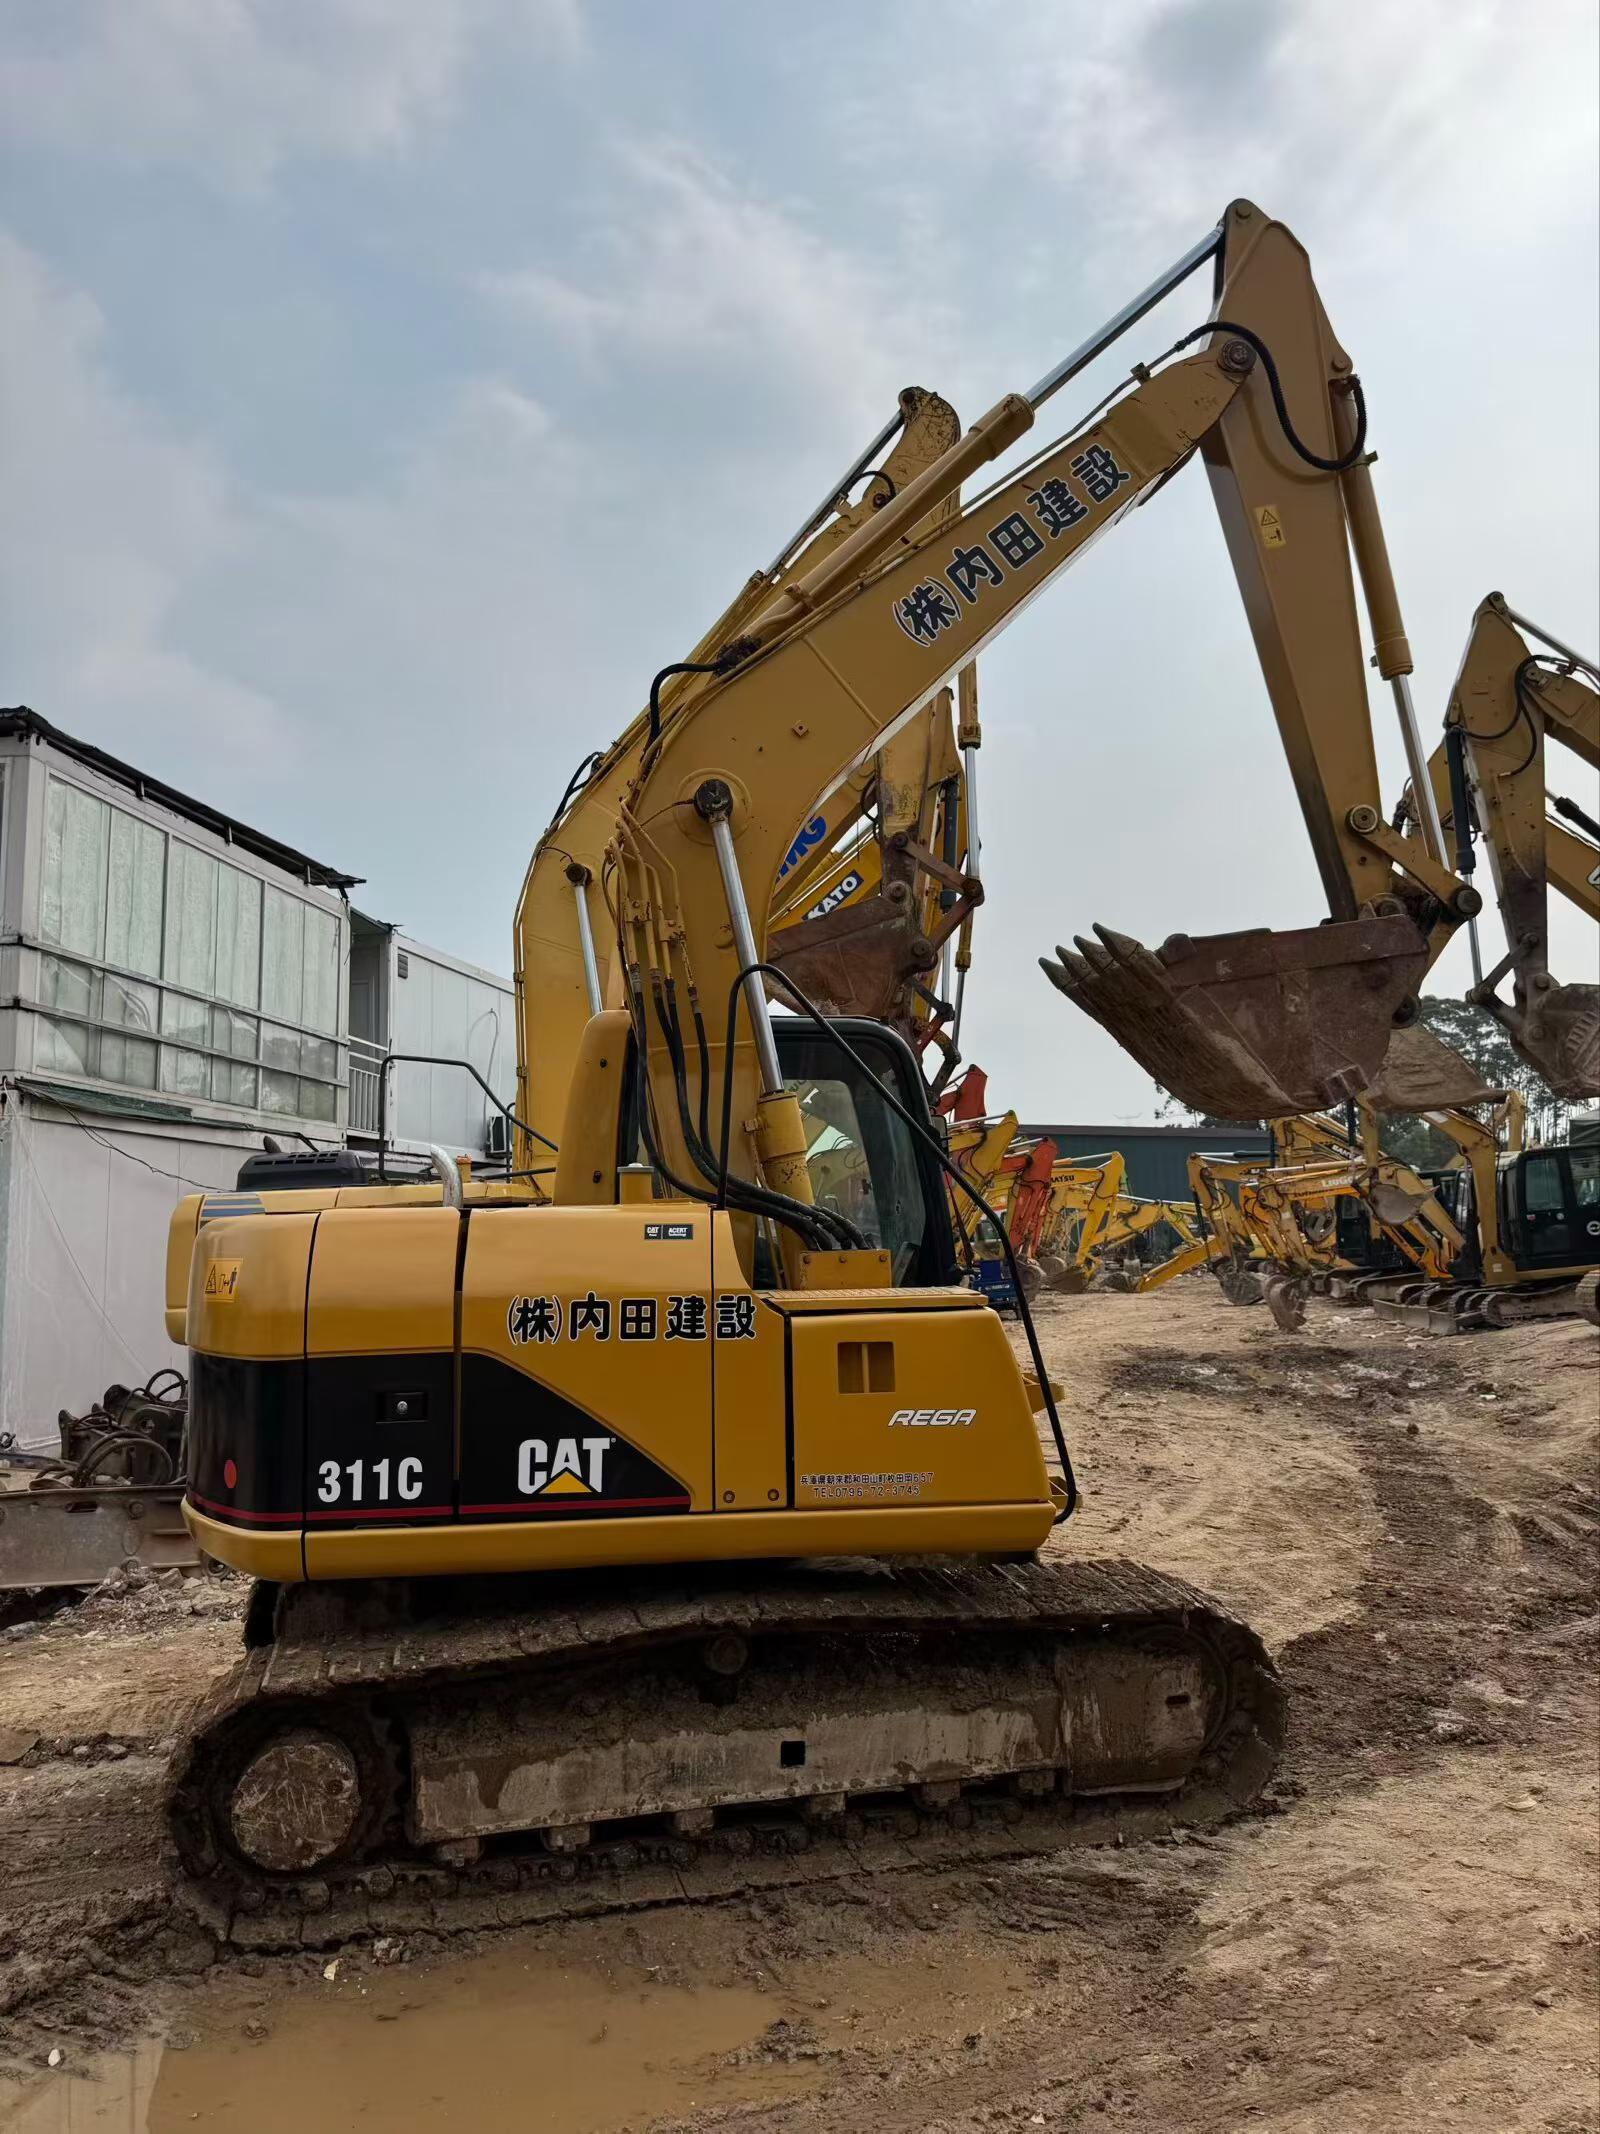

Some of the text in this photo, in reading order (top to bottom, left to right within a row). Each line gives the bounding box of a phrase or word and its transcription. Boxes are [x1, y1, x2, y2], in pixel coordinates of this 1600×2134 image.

[807, 876, 858, 920] KATO
[647, 1226, 660, 1234] CAT
[888, 1409, 977, 1427] REGA
[317, 1457, 423, 1503] 311C
[518, 1437, 611, 1494] CAT
